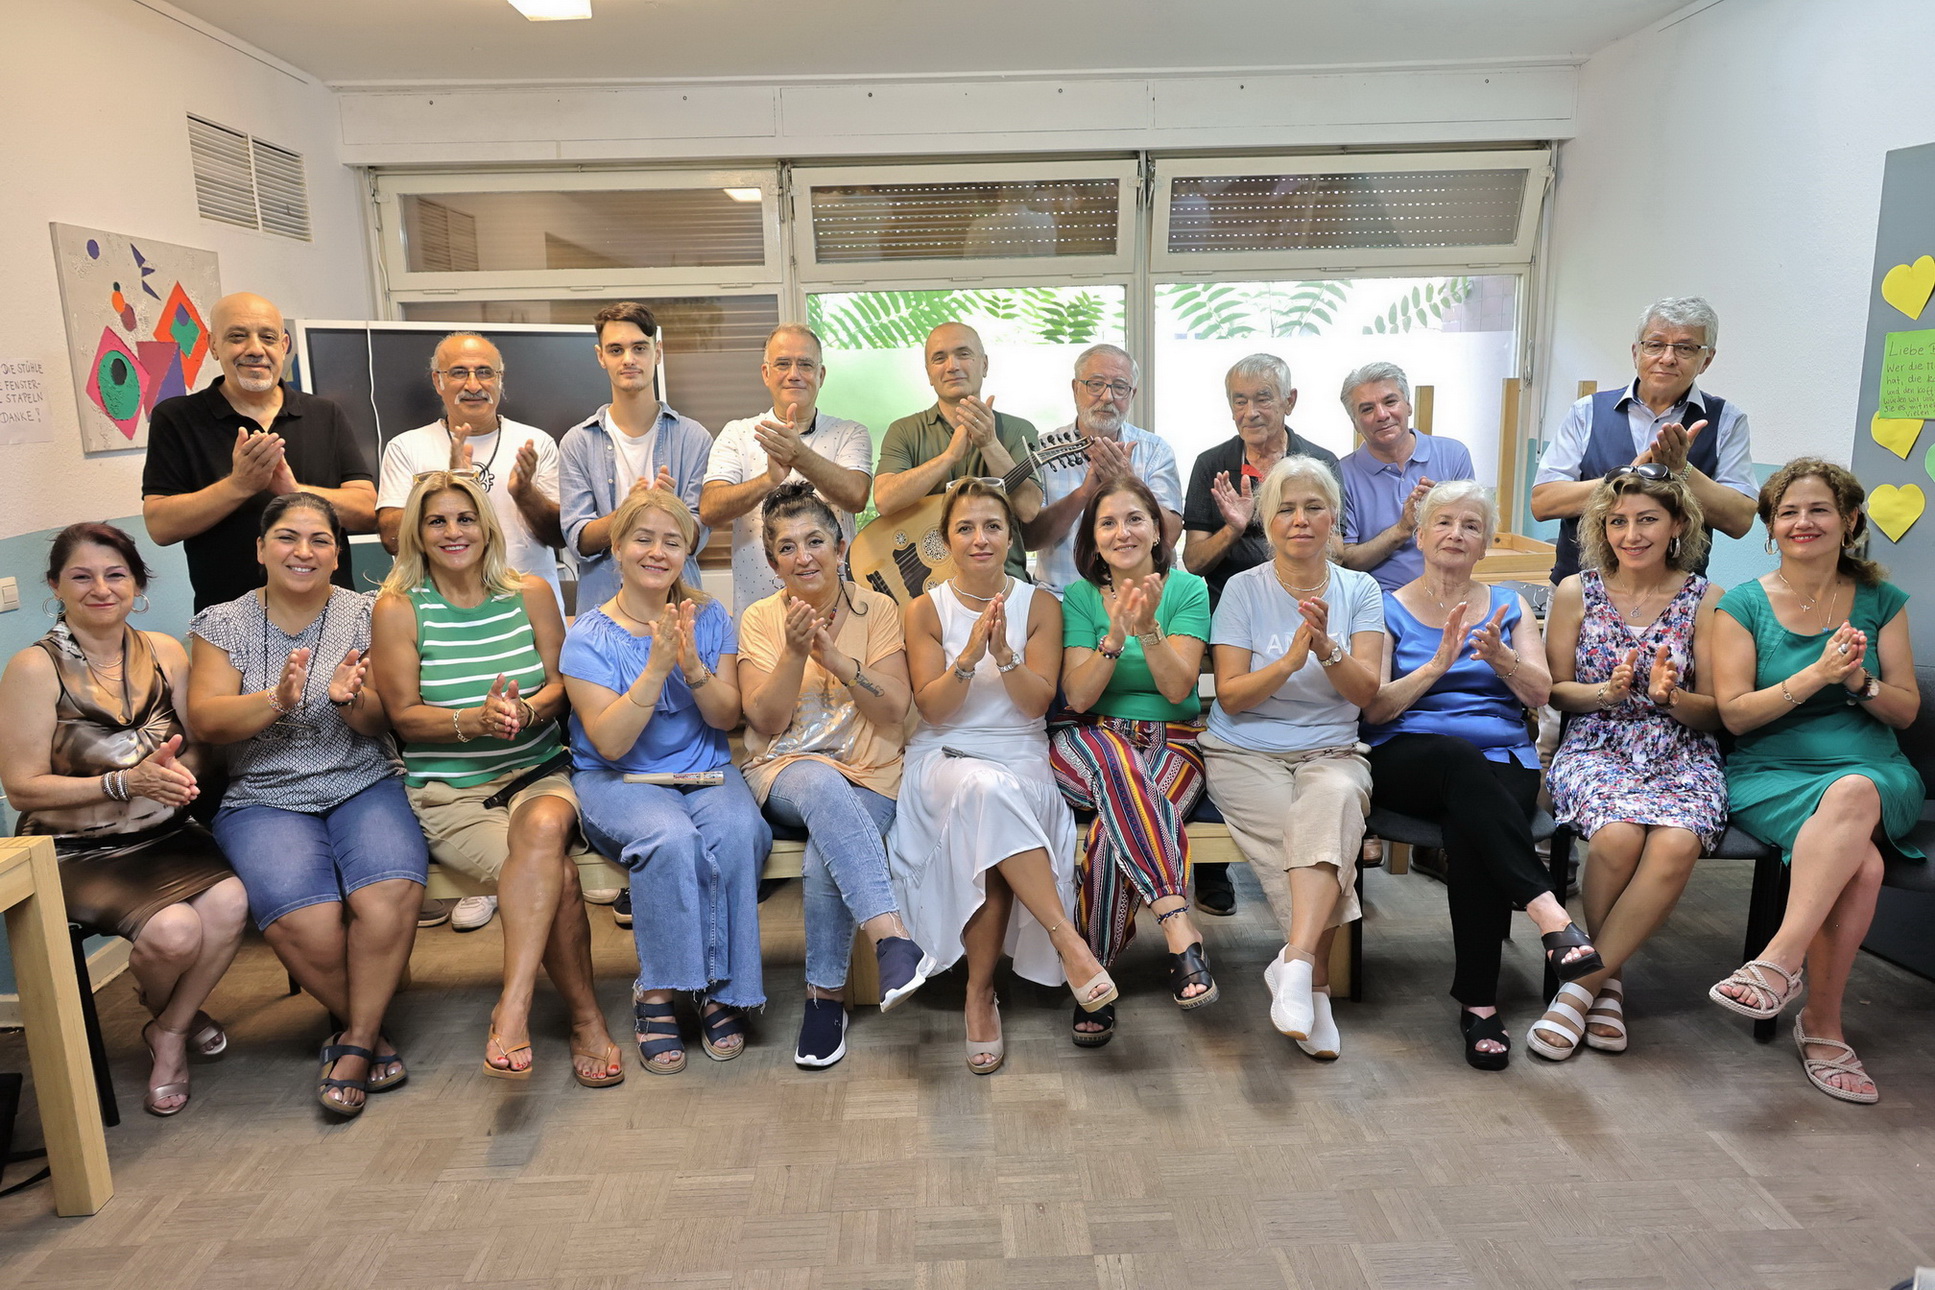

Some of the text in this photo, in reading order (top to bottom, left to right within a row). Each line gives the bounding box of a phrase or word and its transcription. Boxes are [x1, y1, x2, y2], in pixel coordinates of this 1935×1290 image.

[1889, 341, 1924, 356] Liebe
[1886, 363, 1904, 373] Wer
[1909, 361, 1923, 371] die
[1908, 374, 1922, 383] die
[6, 391, 43, 404] STAPELN
